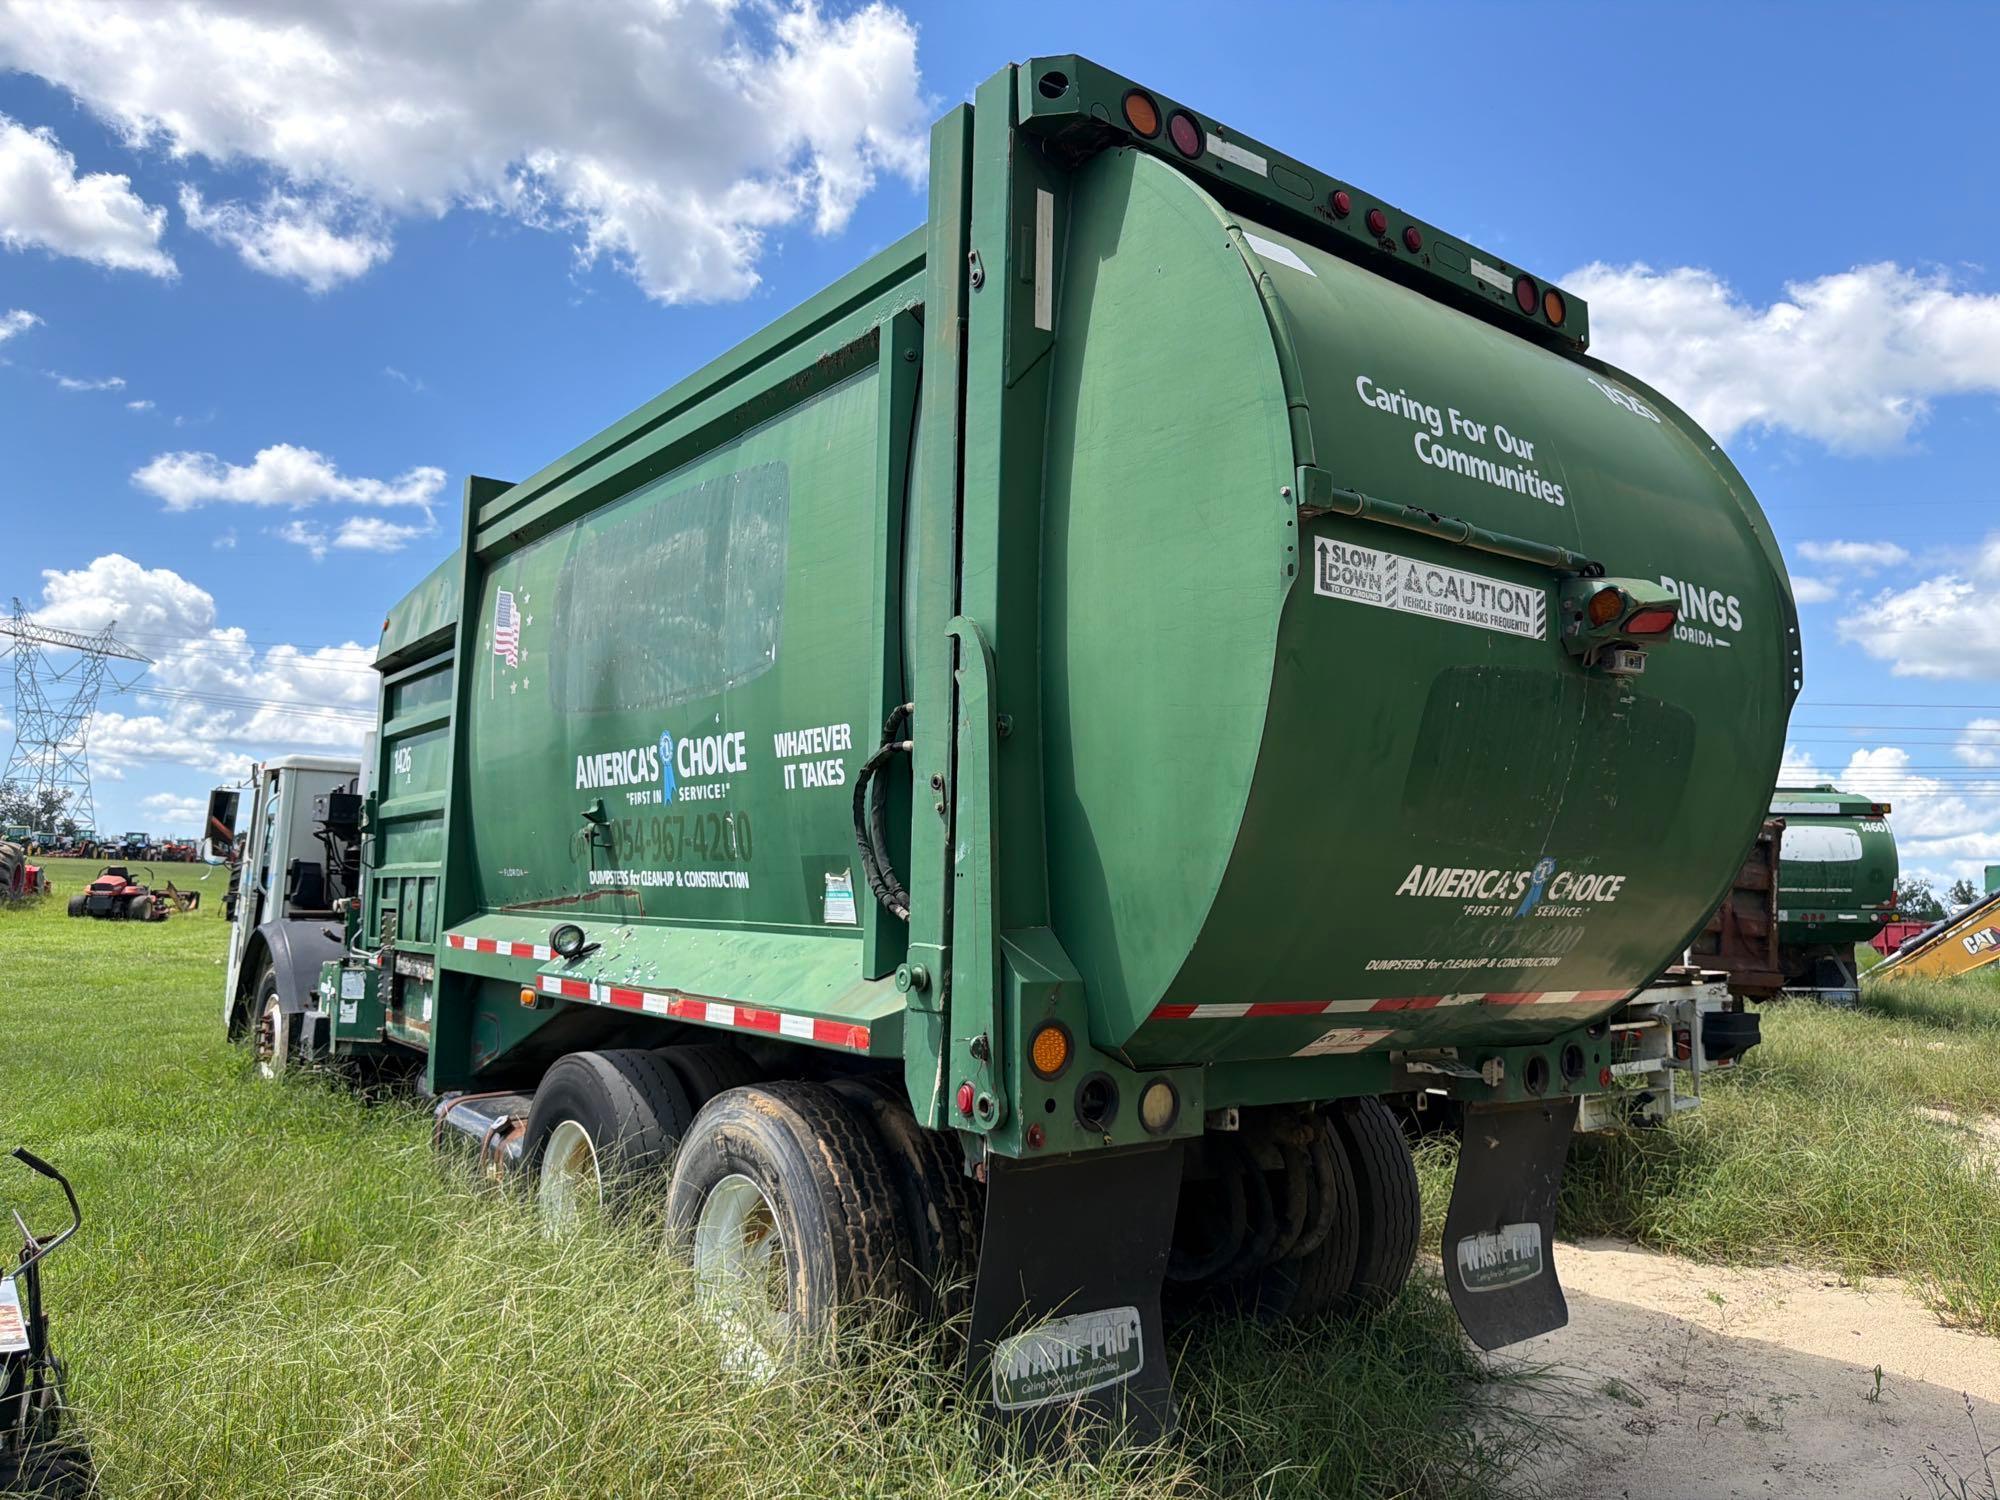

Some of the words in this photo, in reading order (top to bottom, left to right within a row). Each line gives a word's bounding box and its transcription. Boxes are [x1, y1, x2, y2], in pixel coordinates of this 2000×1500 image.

[1356, 375, 1444, 437] Caring
[1448, 407, 1487, 445] For
[1493, 424, 1535, 462] Our
[1414, 431, 1565, 507] Communities
[1332, 544, 1377, 571] SLOW
[1328, 563, 1382, 591] DOWN
[1330, 584, 1340, 593] TO
[1341, 586, 1351, 595] GO
[1352, 589, 1381, 602] AROUND
[1425, 570, 1530, 618] CAUTION
[1402, 595, 1432, 612] VEHICLE
[1434, 602, 1457, 618] STOPS
[1459, 607, 1465, 620] &
[1467, 609, 1489, 624] BACKS
[1490, 614, 1530, 633] FREQUENTLY
[774, 723, 852, 758] WHATEVER
[395, 747, 412, 775] 1426
[575, 744, 660, 789] AMERICA'S
[677, 731, 747, 778] CHOICE
[784, 763, 796, 790] IT
[799, 758, 845, 789] TAKES
[653, 789, 662, 804] IN
[1859, 821, 1886, 833] 1460
[589, 869, 629, 886] DUMPSTERS
[629, 869, 641, 886] for
[641, 870, 674, 887] CLEAN-UP
[676, 870, 684, 887] &
[684, 870, 750, 889] CONSTRUCTION
[1395, 864, 1532, 900] AMERICA'S
[1548, 871, 1626, 902] CHOICE
[1501, 905, 1513, 917] IN
[1962, 927, 1998, 955] CAT
[1364, 958, 1425, 971] DUMPSTERS
[1425, 958, 1443, 970] for
[1487, 957, 1498, 968] &
[1497, 956, 1562, 968] CONSTRUCTION
[1008, 1334, 1083, 1381] WASTE
[1089, 1323, 1131, 1360] PRO
[1021, 1379, 1047, 1394] Caring
